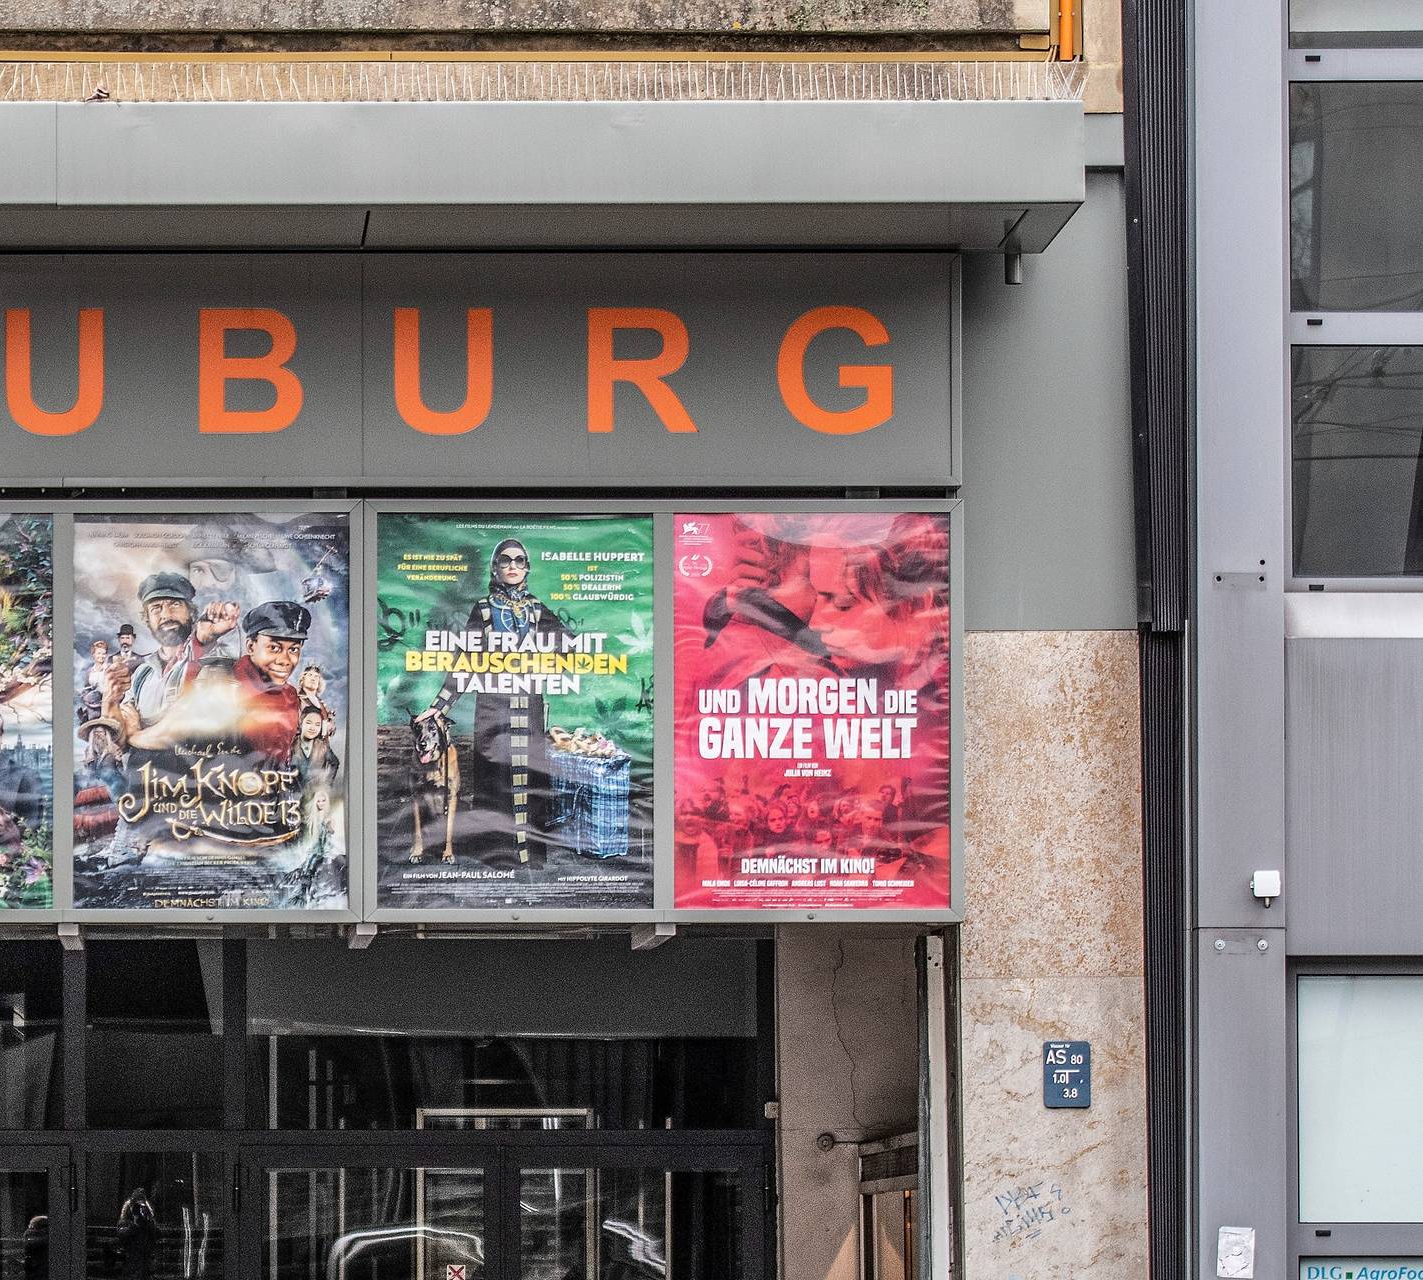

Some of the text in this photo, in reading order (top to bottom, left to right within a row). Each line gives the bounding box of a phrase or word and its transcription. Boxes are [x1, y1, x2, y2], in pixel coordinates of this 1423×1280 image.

[446, 553, 463, 561] SPÄT
[541, 551, 645, 561] ISABELLE HUPPERT
[397, 562, 411, 571] FÜR
[427, 564, 468, 572] BERUFLICHE
[581, 583, 621, 591] DEALERIN
[572, 592, 634, 601] GLAUBWÜRDIG
[425, 631, 608, 654] EINE FRAU MIT
[405, 651, 628, 675] BERAUSCHENDEN
[452, 673, 581, 695] TALENTEN
[698, 677, 917, 715] UND MORGEN DIE
[698, 717, 917, 759] GANZE WELT
[153, 802, 177, 814] UND
[179, 809, 198, 820] DIE
[278, 799, 301, 827] 13
[741, 855, 875, 874] DEMNÄCHST IM KINO!
[438, 871, 481, 879] JEAN-PAUL
[482, 869, 515, 879] SALOMÉ
[1045, 1049, 1083, 1065] AS 80
[1063, 1088, 1078, 1098] 3,8
[1307, 1266, 1343, 1280] DLG
